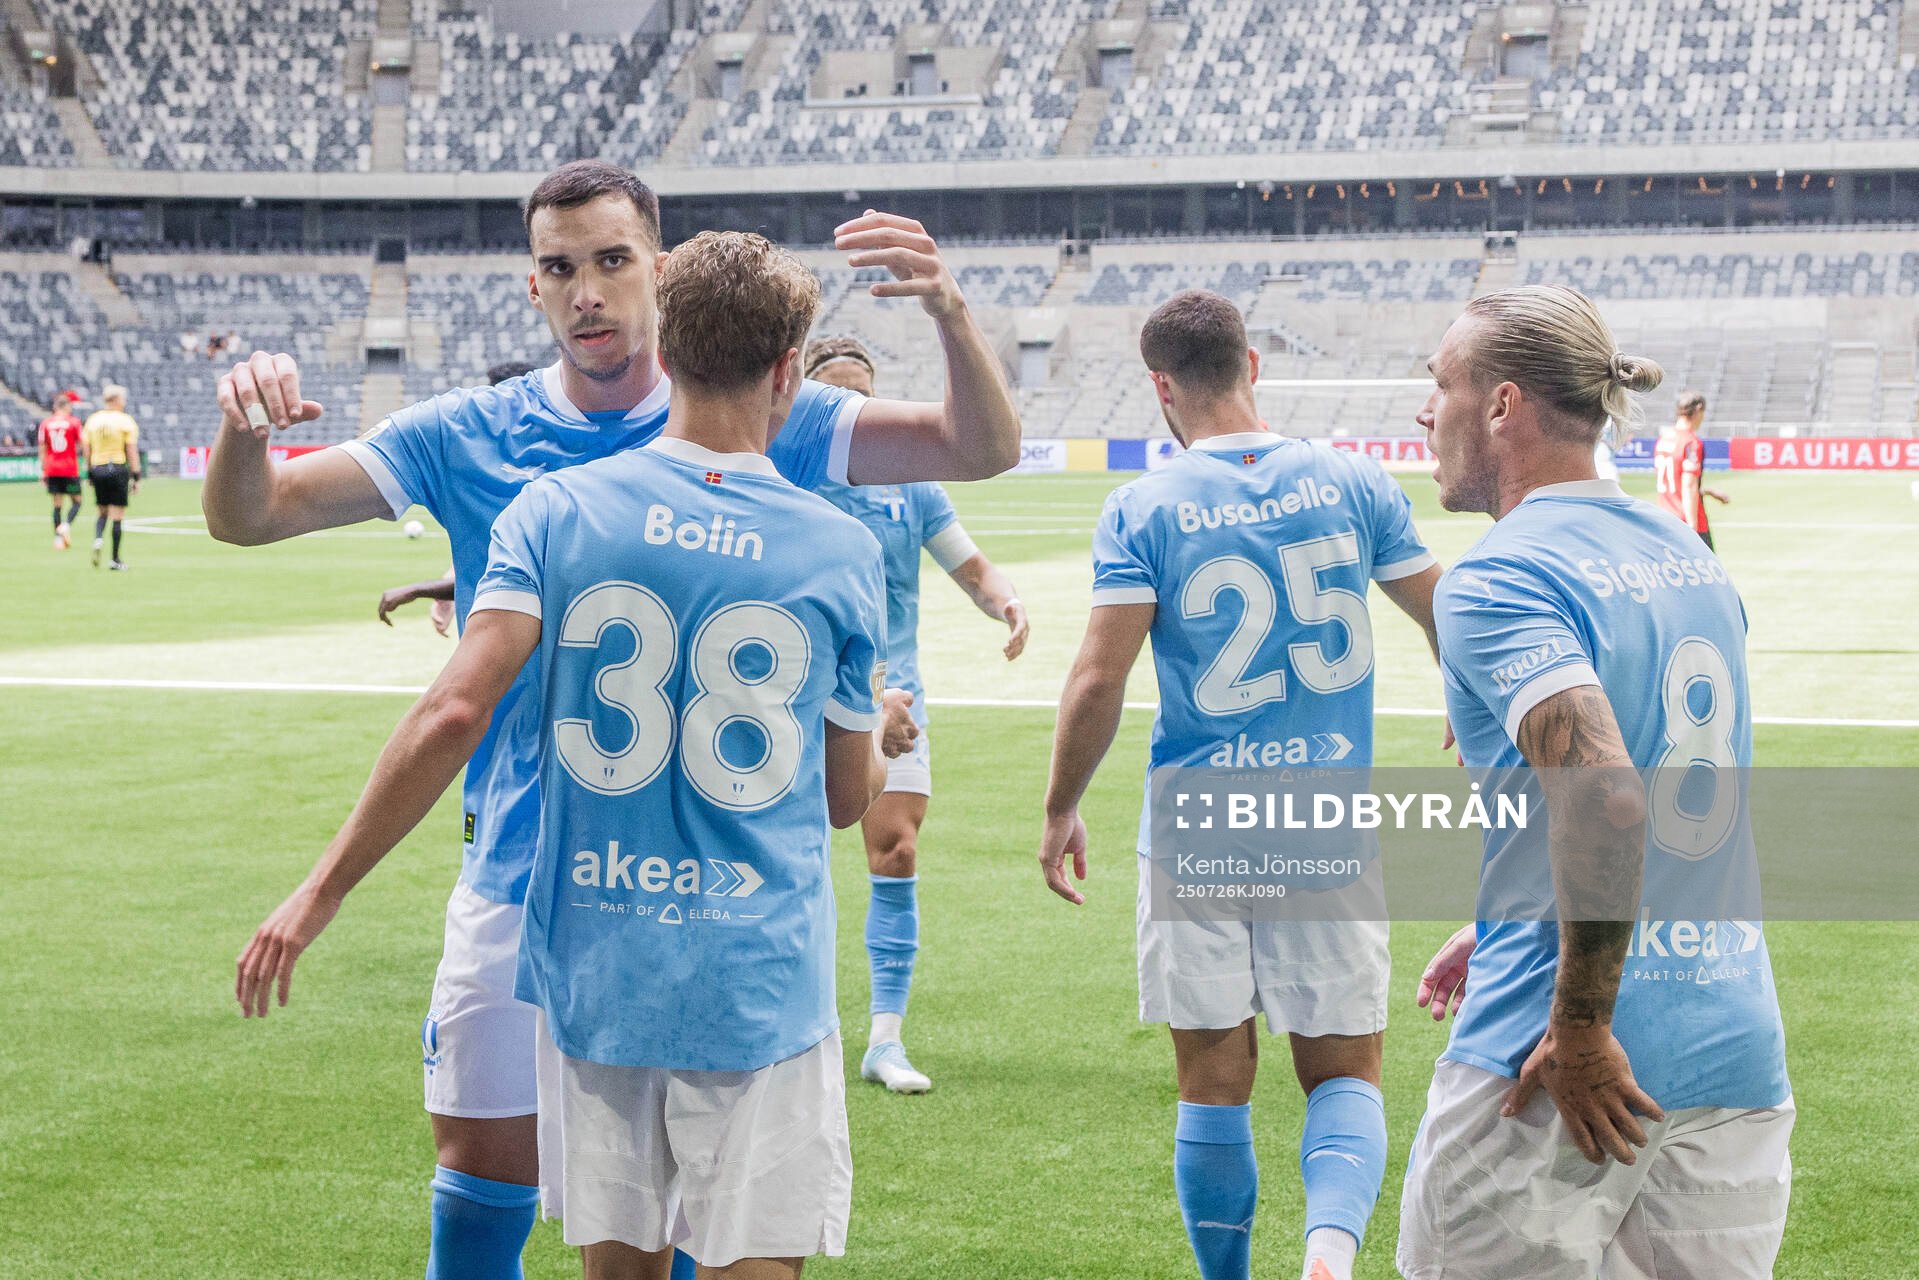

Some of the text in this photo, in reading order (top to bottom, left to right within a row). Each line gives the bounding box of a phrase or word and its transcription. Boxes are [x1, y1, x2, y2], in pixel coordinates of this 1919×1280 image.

[1754, 442, 1919, 467] BAUHAUS
[644, 503, 764, 560] Bolin
[1176, 477, 1342, 533] Busanello
[1181, 531, 1374, 716] 25
[554, 580, 811, 812] 38
[1209, 733, 1309, 768] akea
[1648, 635, 1739, 861] 8
[572, 840, 701, 895] akea
[600, 901, 731, 921] PART OF ELEDA
[1625, 906, 1720, 958] kea
[1634, 967, 1750, 981] PART OF ELEDA
